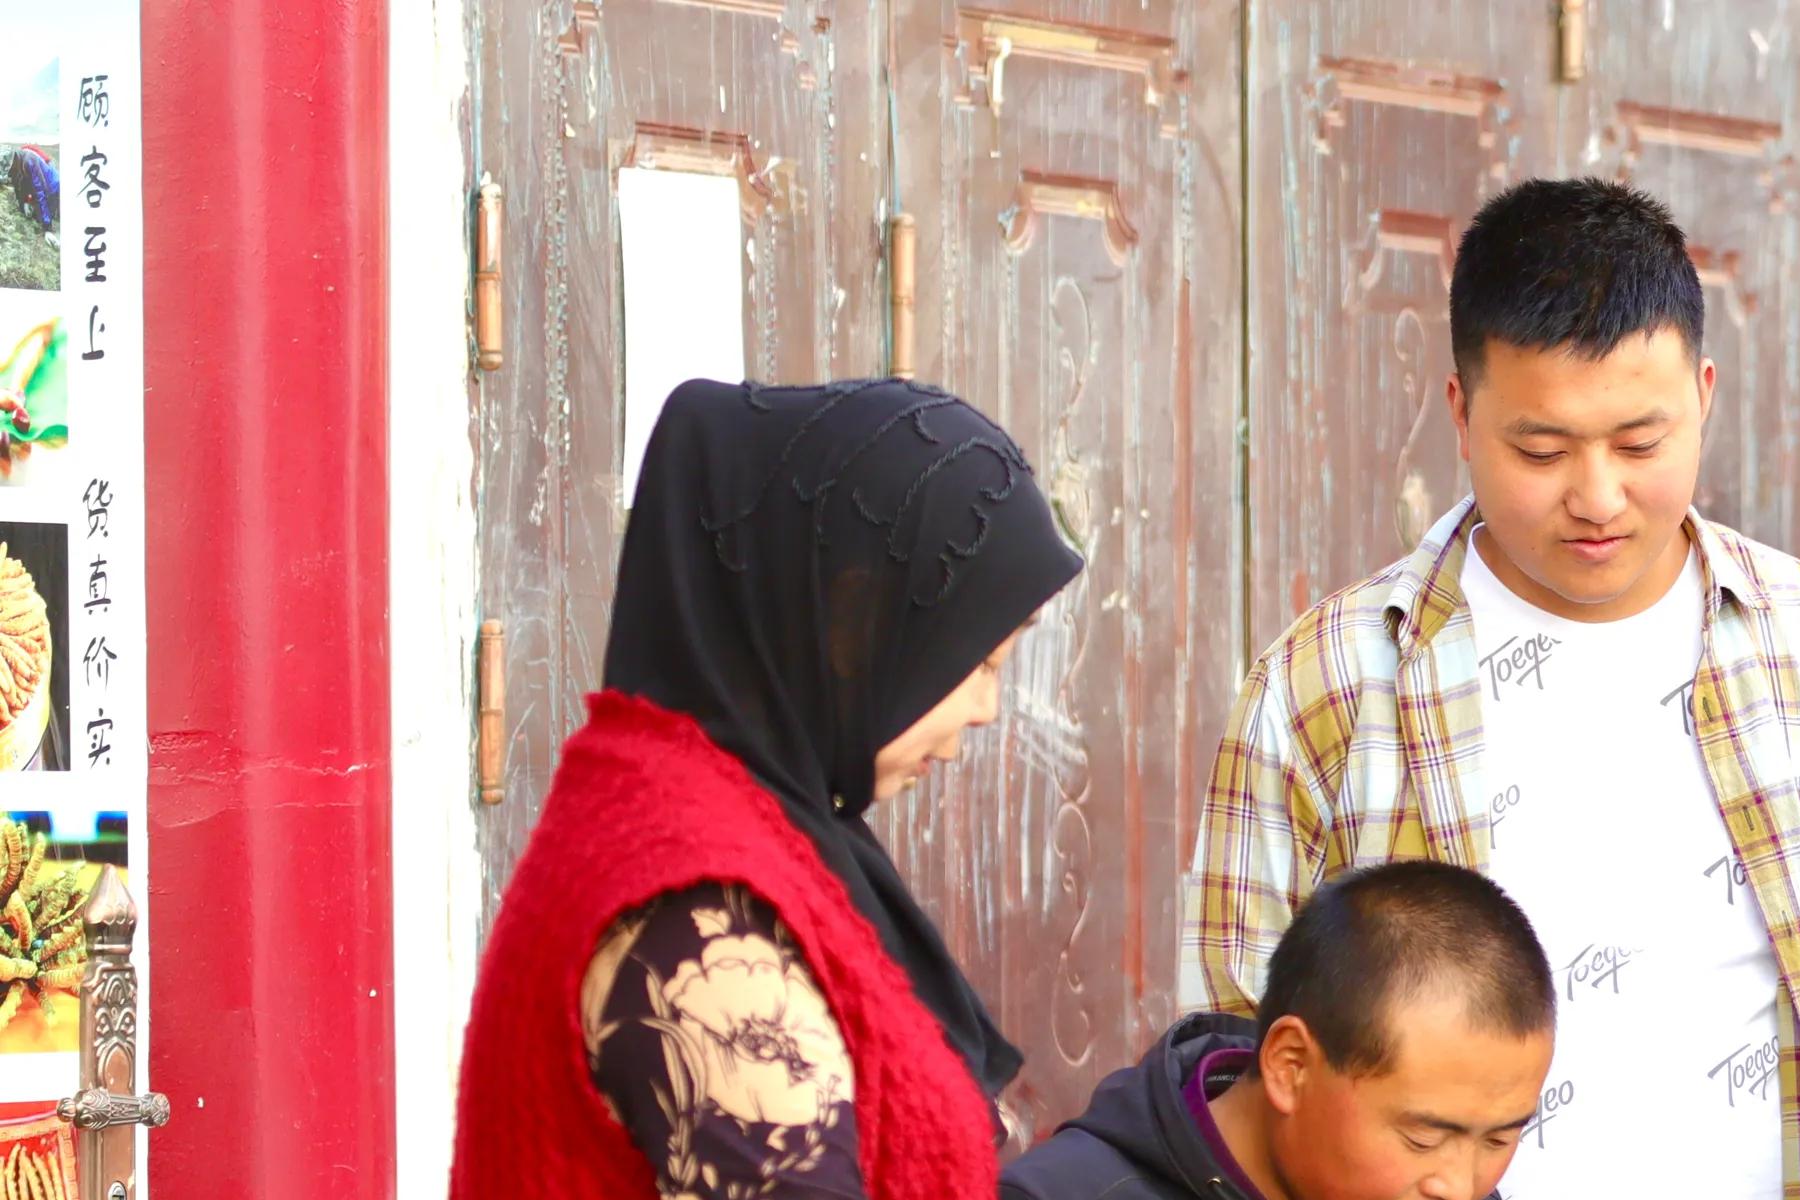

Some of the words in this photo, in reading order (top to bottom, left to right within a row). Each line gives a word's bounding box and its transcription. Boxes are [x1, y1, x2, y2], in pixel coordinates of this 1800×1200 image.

[78, 74, 111, 361] 顾客至上
[83, 478, 118, 768] 货真价实
